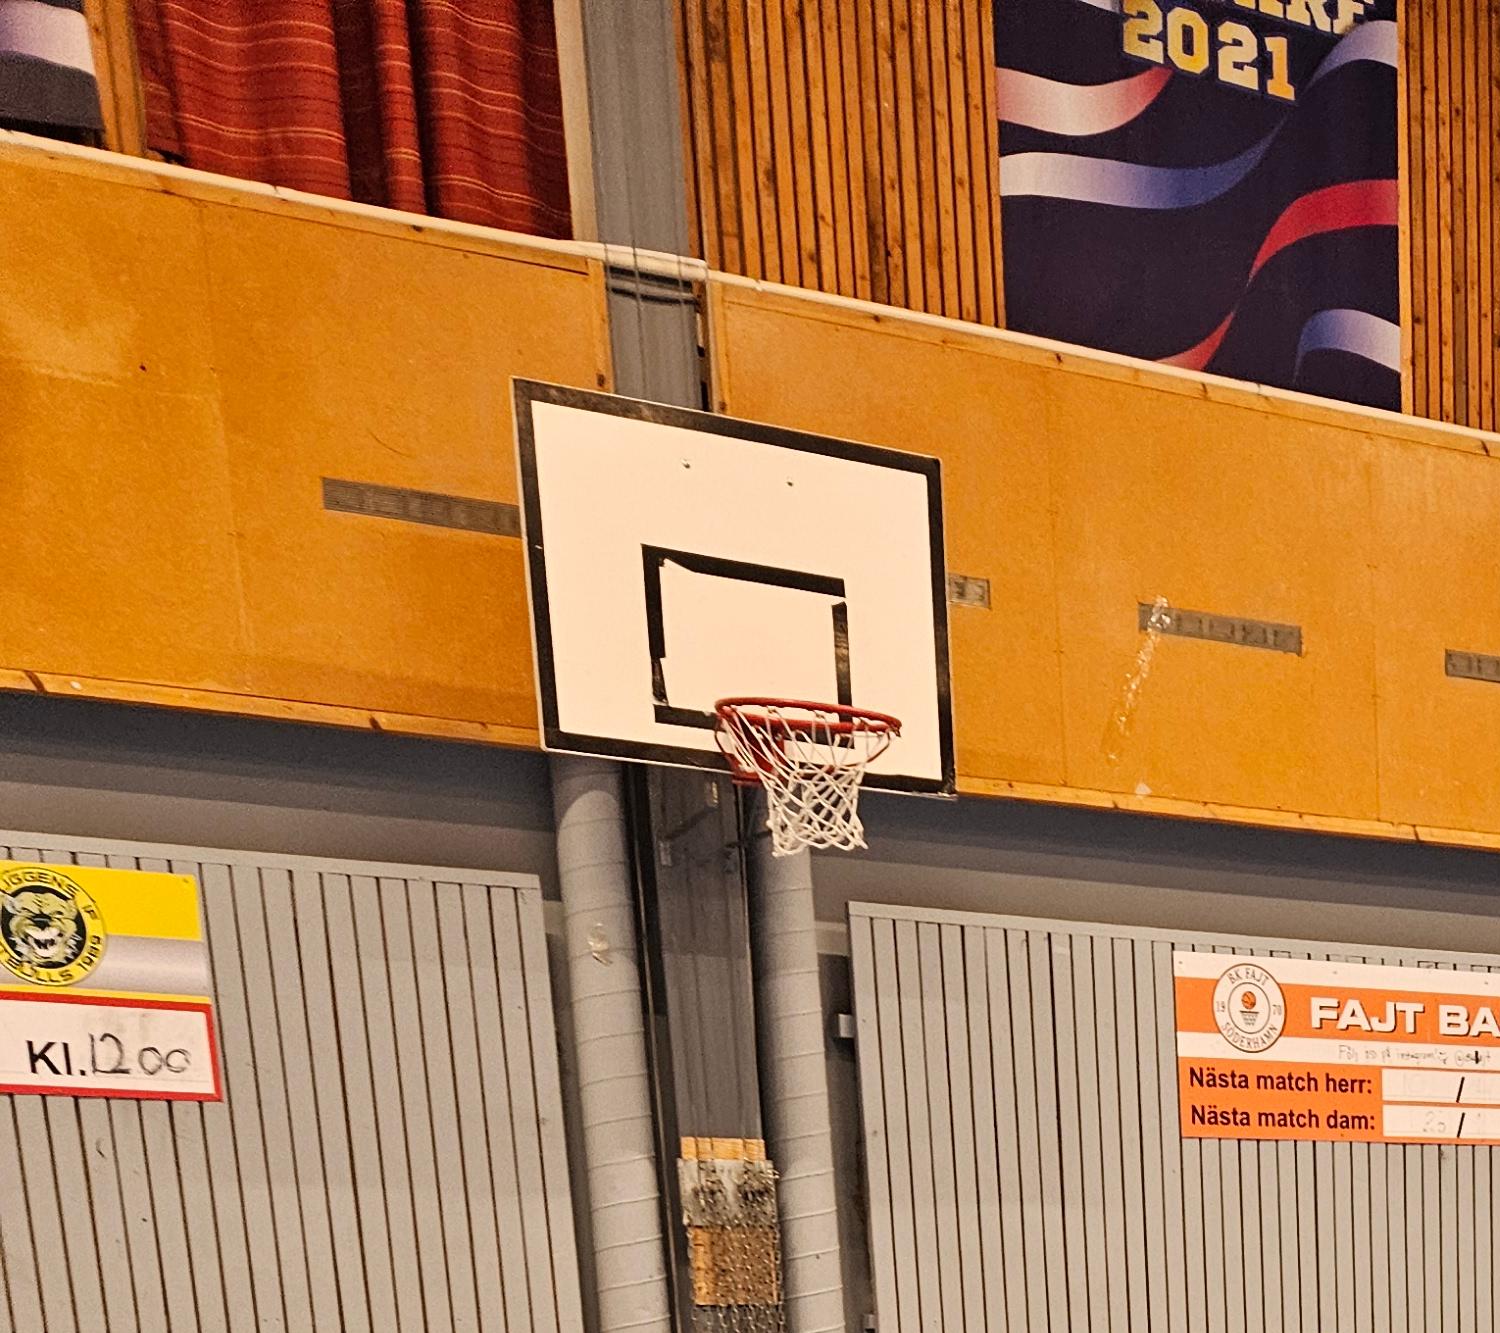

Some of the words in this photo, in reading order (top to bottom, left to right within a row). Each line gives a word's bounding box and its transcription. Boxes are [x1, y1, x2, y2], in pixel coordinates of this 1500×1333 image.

[1123, 0, 1296, 100] 2021
[1245, 967, 1269, 986] FAJT
[1310, 997, 1425, 1034] FAJT
[1189, 1066, 1250, 1089] Nästa
[1256, 1071, 1319, 1092] match
[1325, 1073, 1373, 1094] herr:
[1191, 1104, 1251, 1127] Nästa
[1257, 1108, 1321, 1128] match
[1326, 1109, 1376, 1130] dam:
